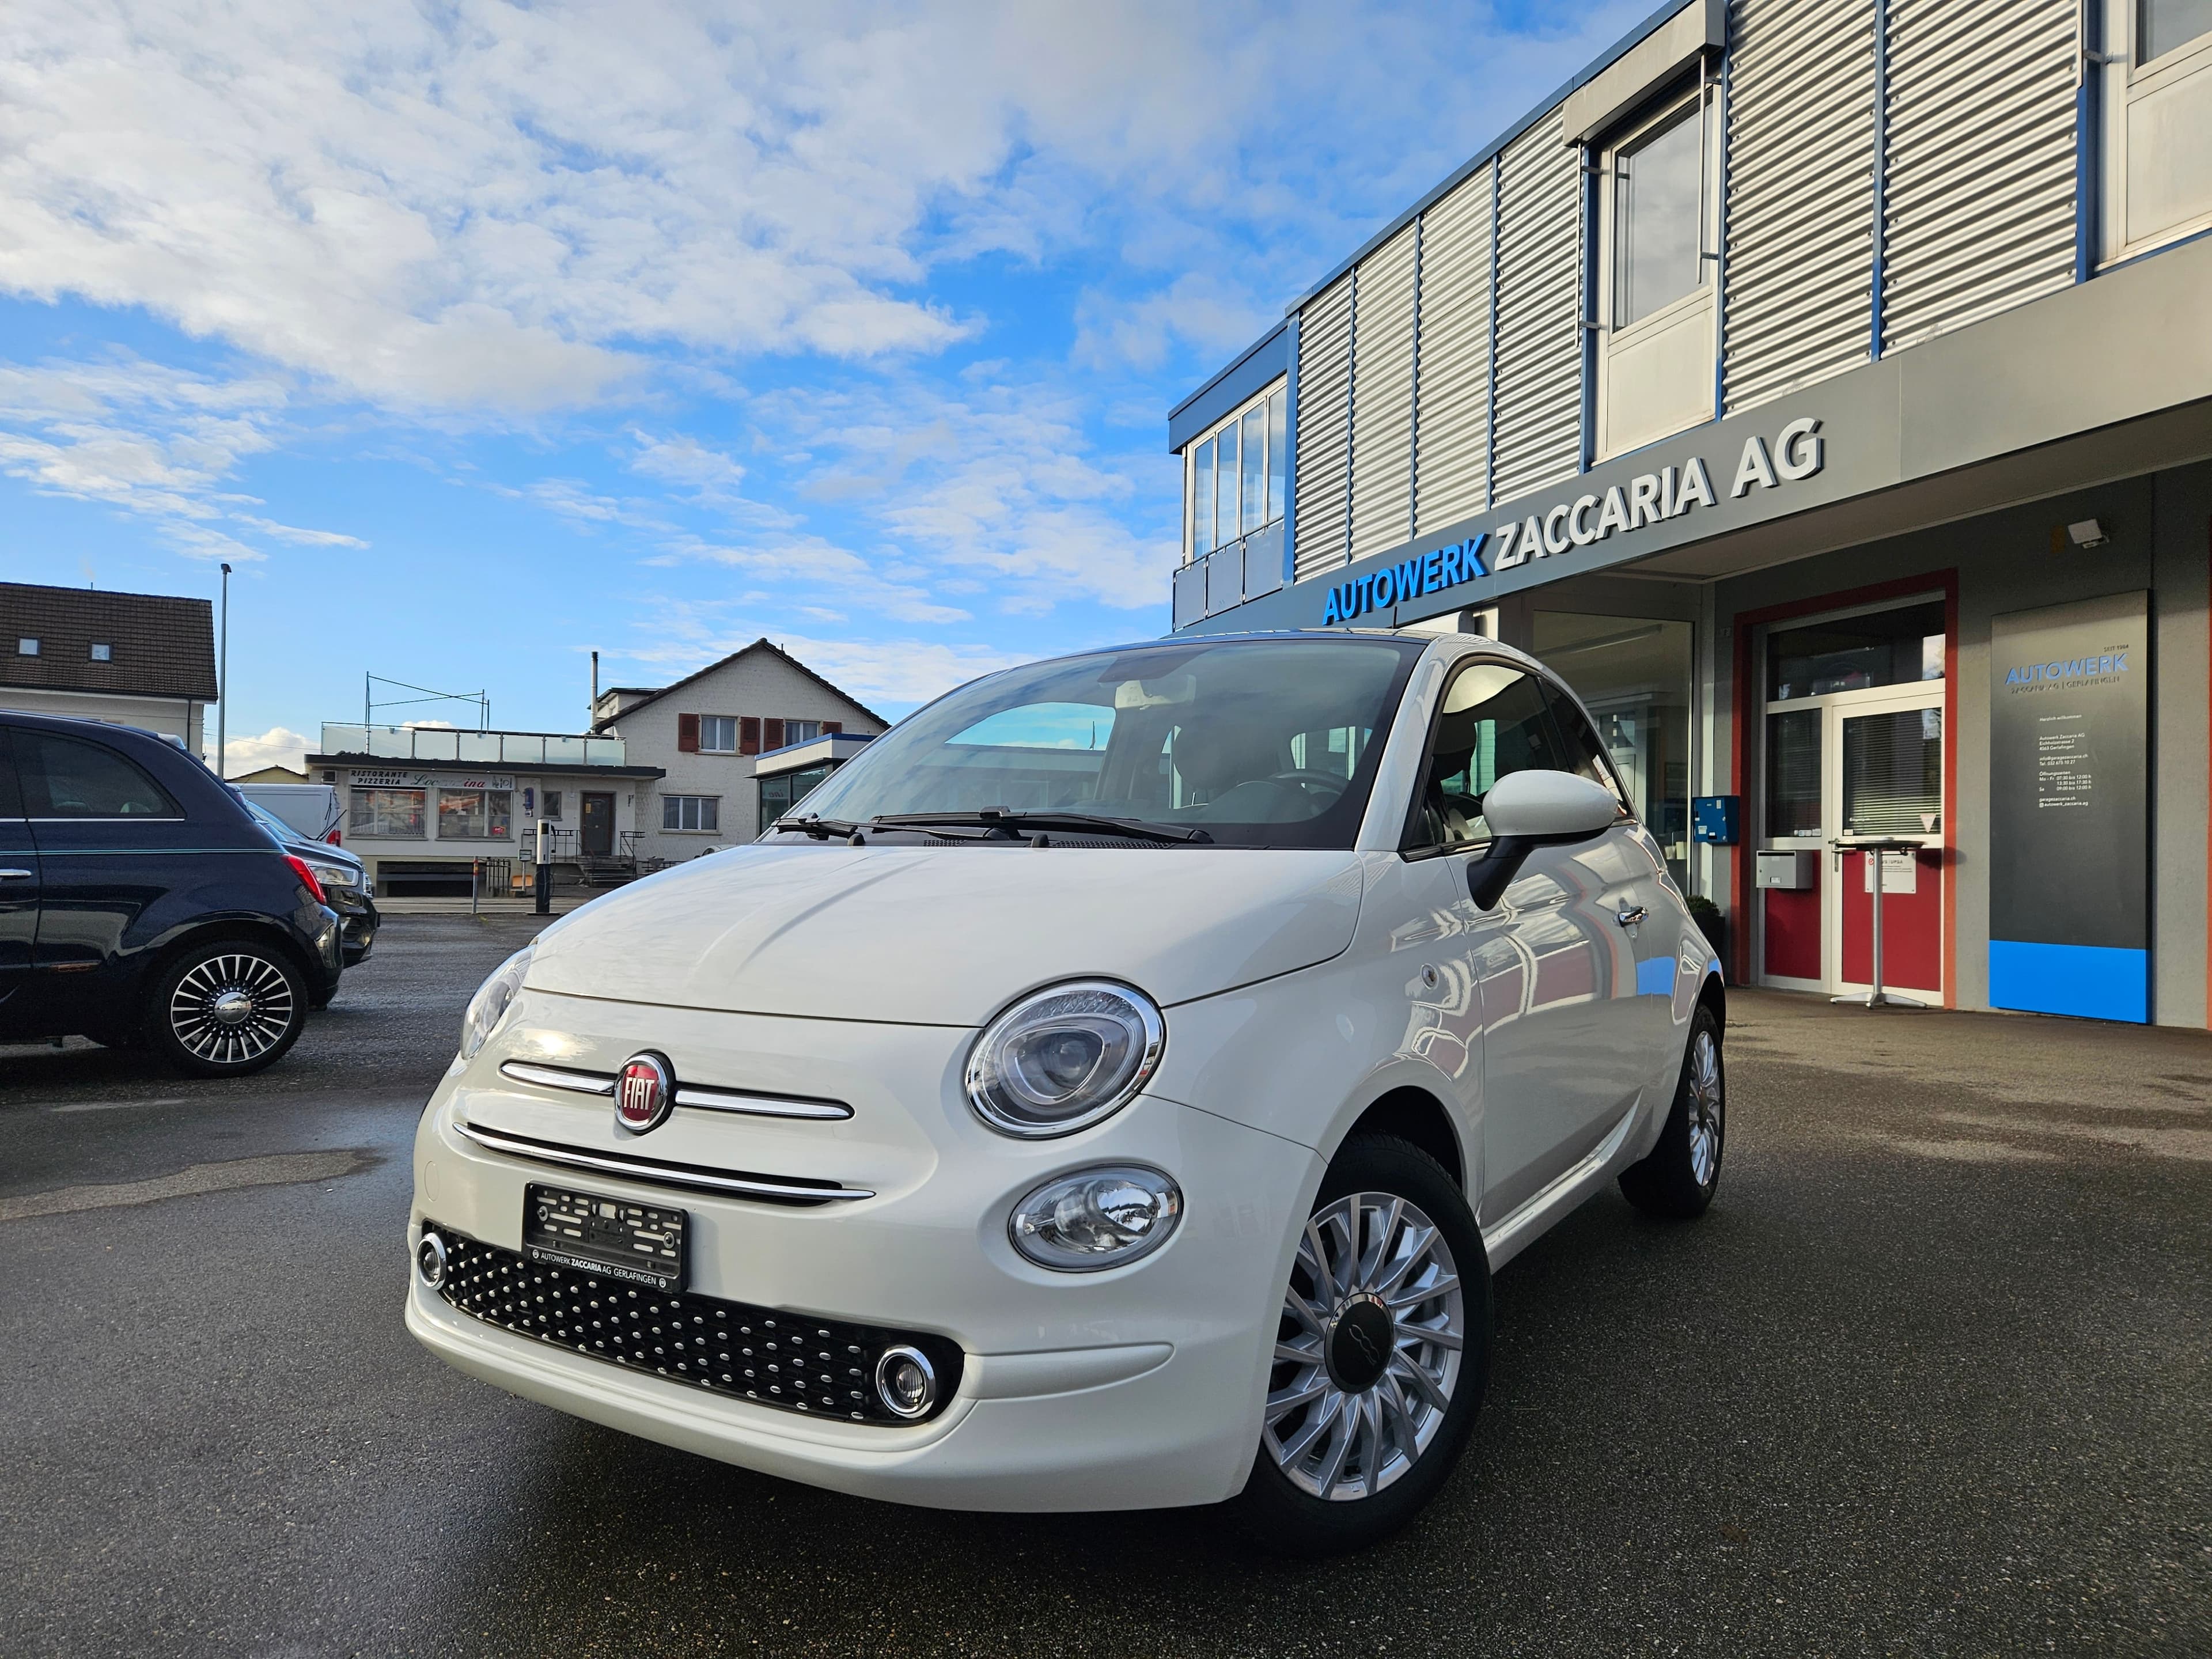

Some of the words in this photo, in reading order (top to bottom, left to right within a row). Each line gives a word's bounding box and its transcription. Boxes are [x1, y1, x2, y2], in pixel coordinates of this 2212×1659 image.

[1322, 533, 1491, 626] AUTOWERK
[1494, 457, 1716, 570] ZACCARIA
[1729, 417, 1823, 498] AG
[2005, 653, 2129, 685] AUTOWERK
[351, 770, 408, 778] RISTORANTE
[623, 1077, 655, 1111] FIAT
[540, 1252, 570, 1266] AUTOWERK
[570, 1258, 601, 1272] ZACCARIA
[602, 1266, 612, 1274] AG
[613, 1268, 656, 1285] GERLAFINGEN
